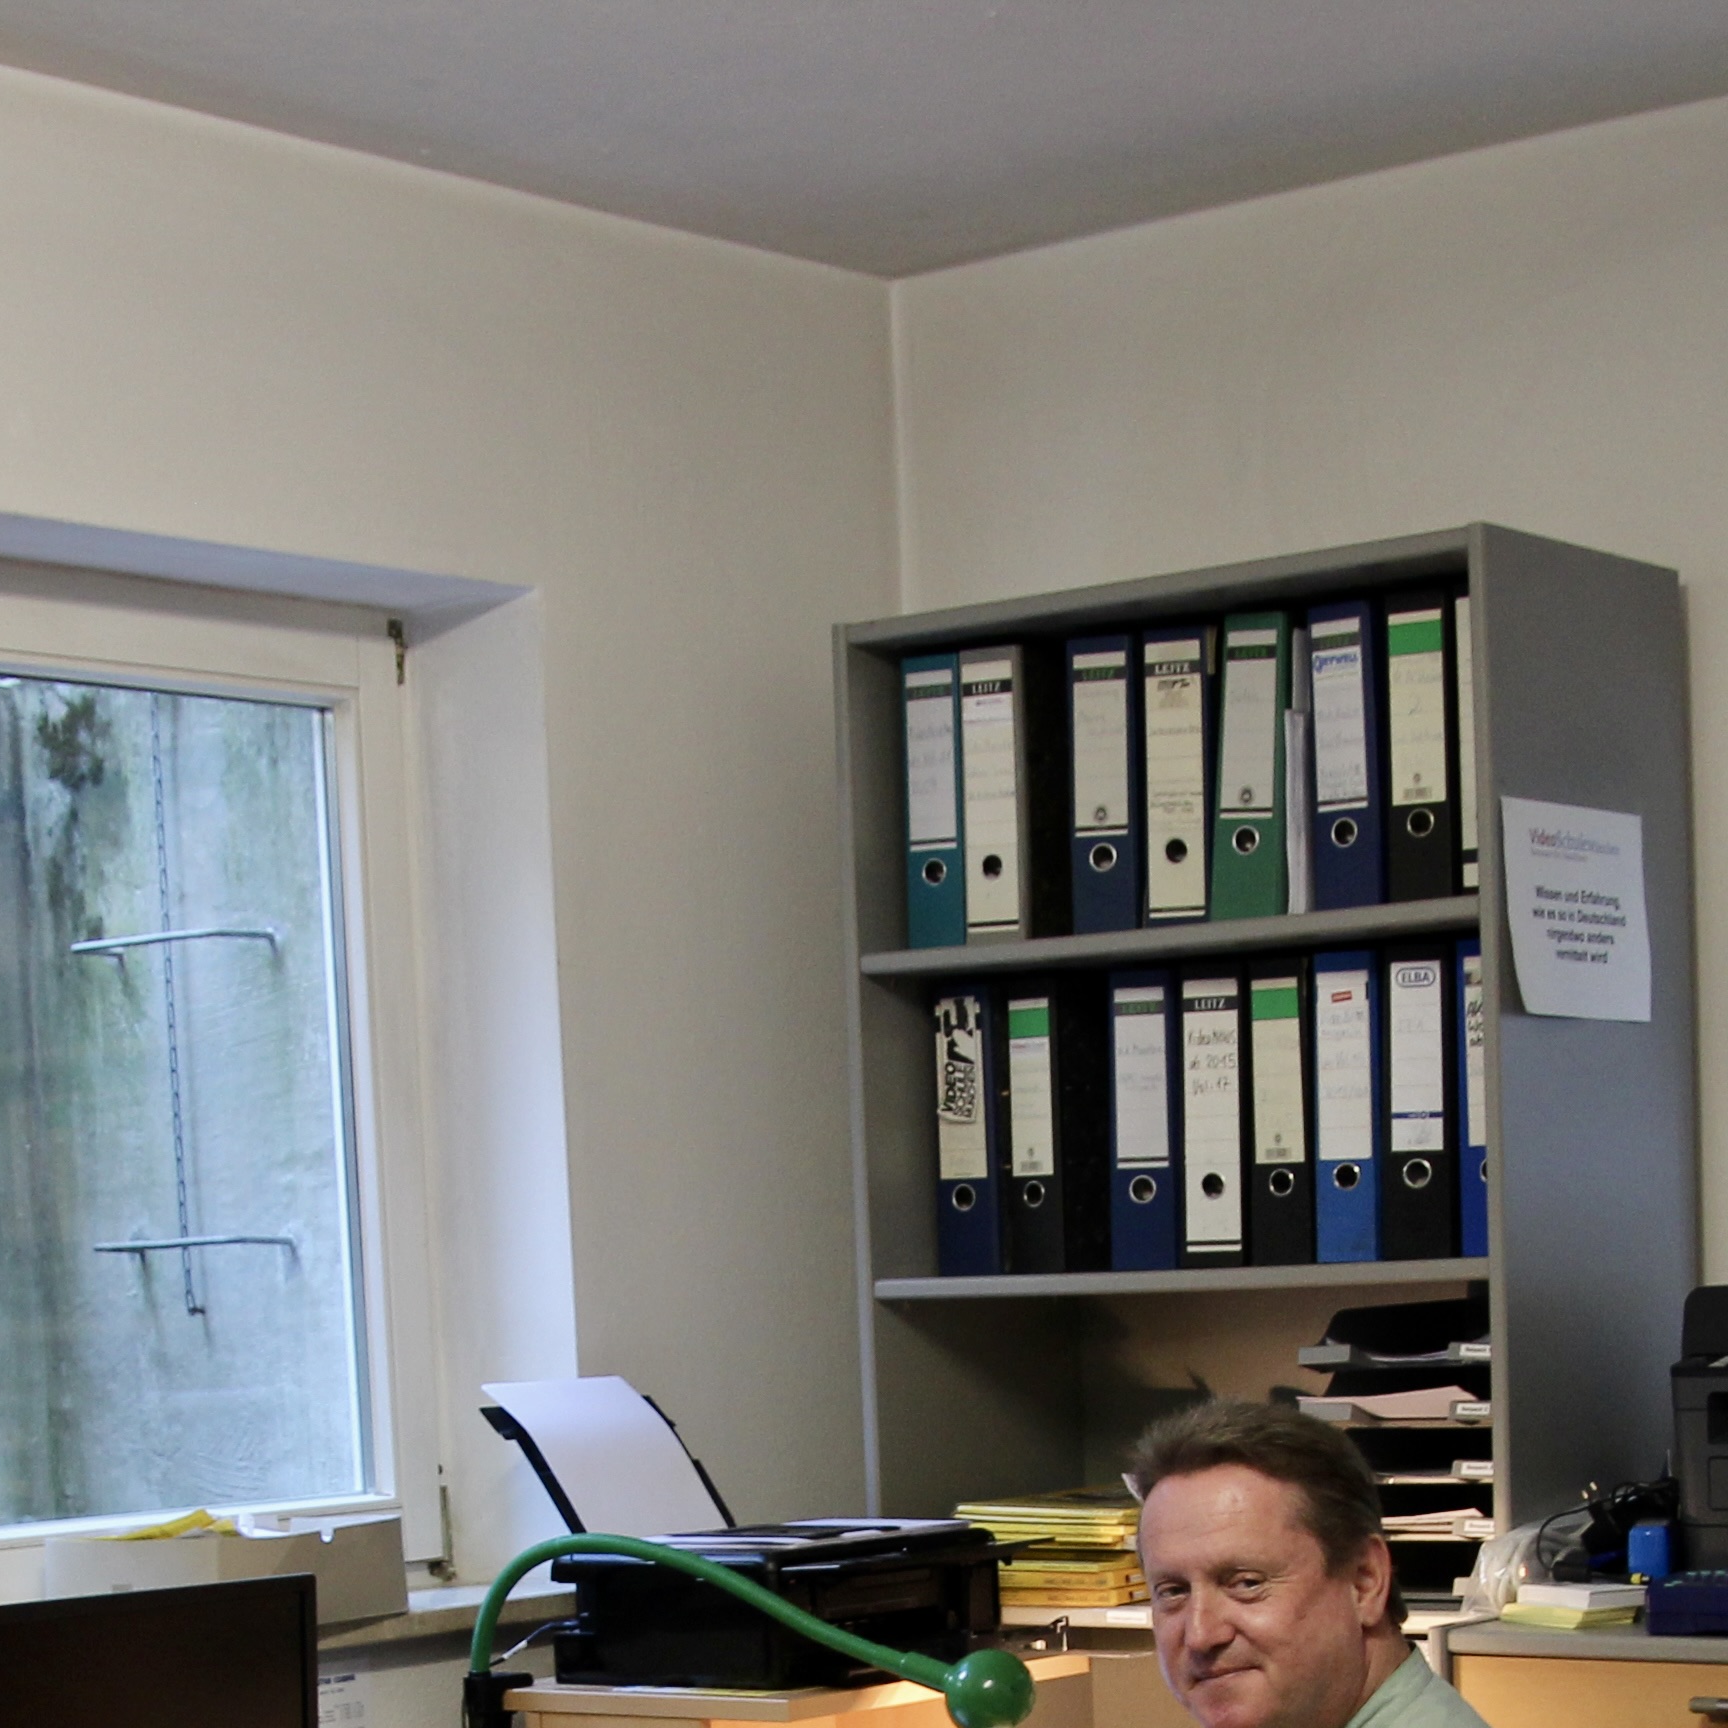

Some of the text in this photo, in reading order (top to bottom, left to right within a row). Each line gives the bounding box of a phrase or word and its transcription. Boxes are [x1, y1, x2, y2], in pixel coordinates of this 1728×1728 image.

[1154, 662, 1191, 675] LEITZ
[971, 681, 1002, 695] LEITZ
[1564, 890, 1579, 904] und
[1577, 909, 1627, 927] Deutschland
[1400, 967, 1432, 985] ELBA
[1193, 997, 1227, 1011] LEITZ
[941, 1061, 957, 1113] VIDEO
